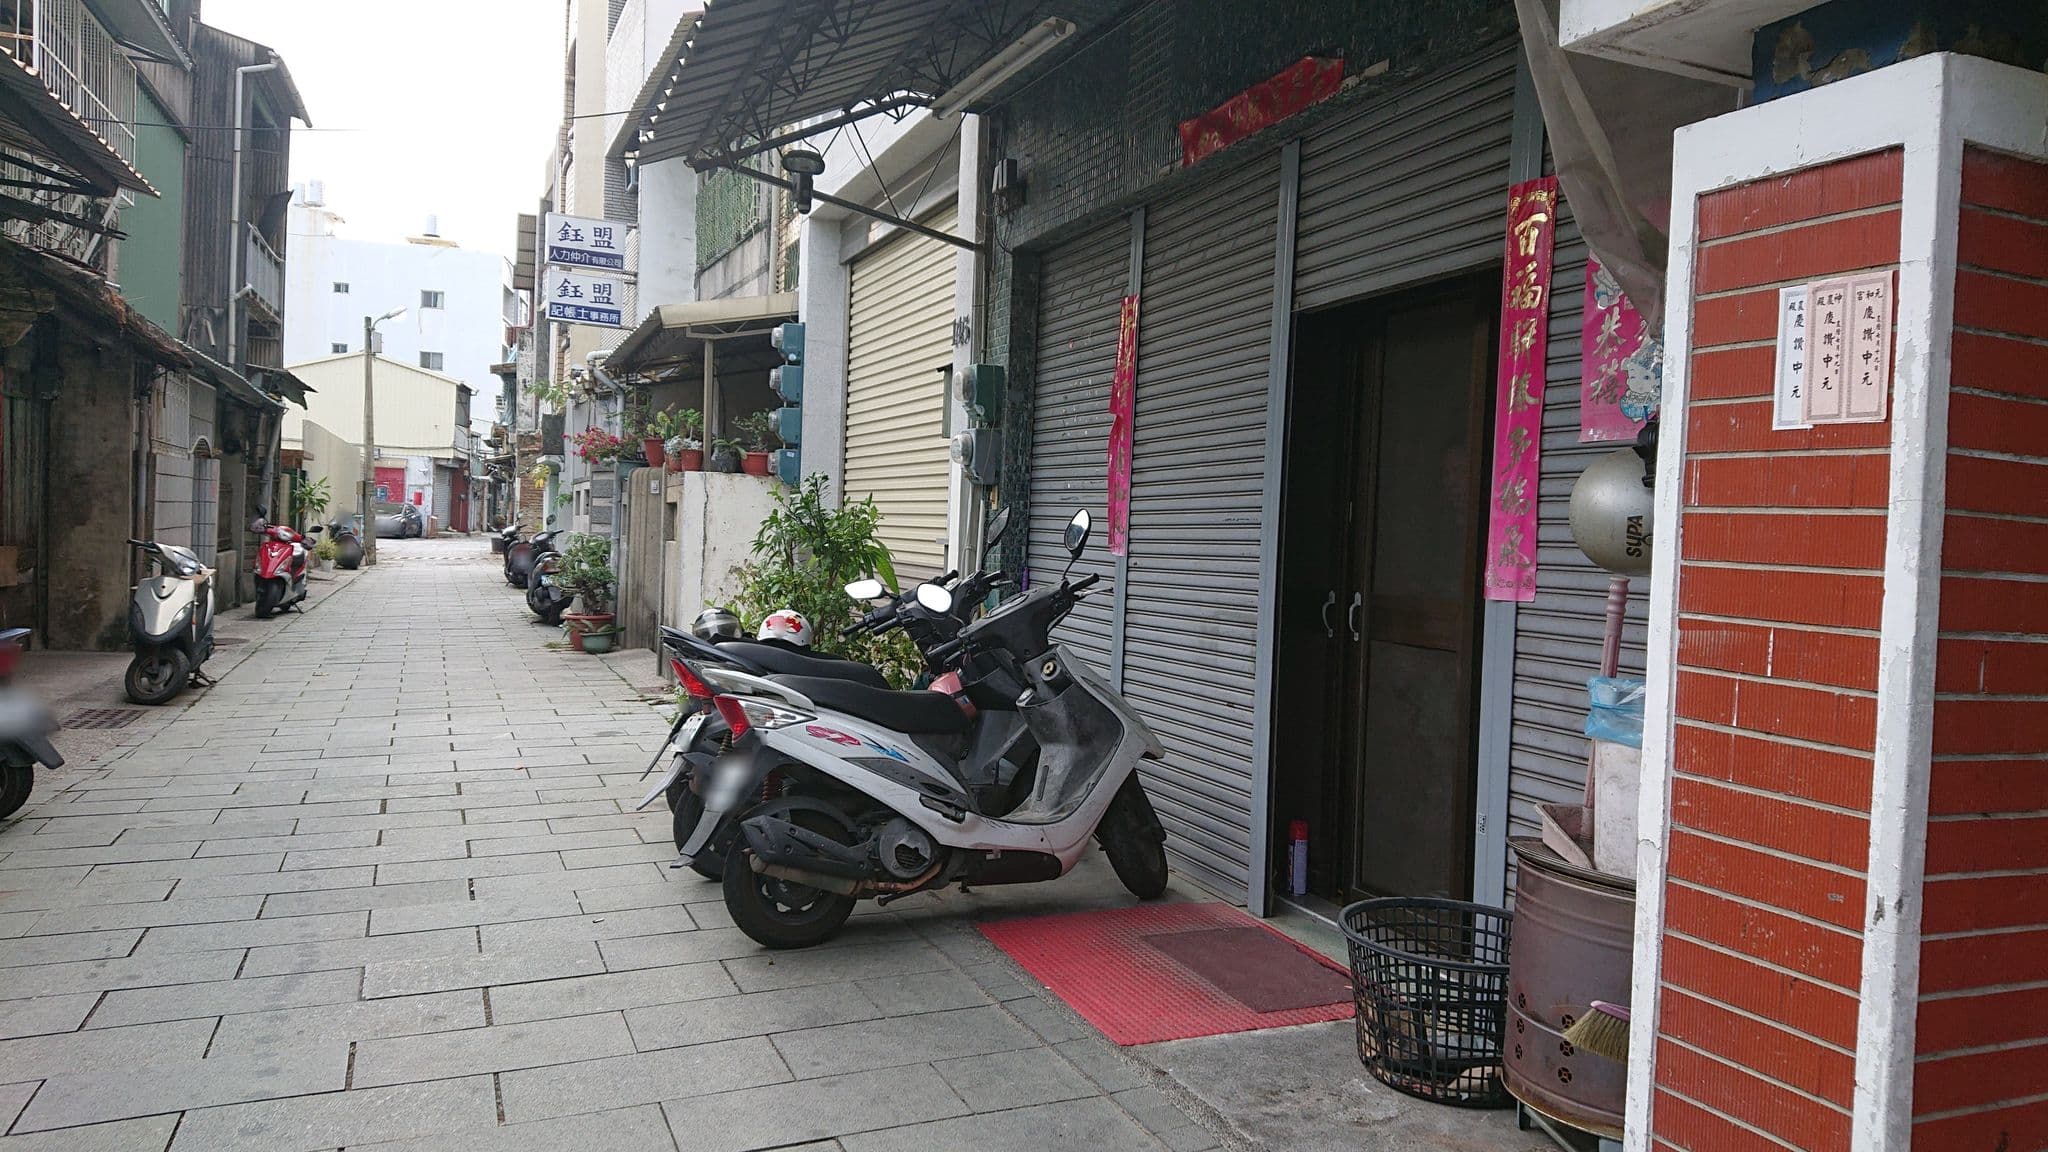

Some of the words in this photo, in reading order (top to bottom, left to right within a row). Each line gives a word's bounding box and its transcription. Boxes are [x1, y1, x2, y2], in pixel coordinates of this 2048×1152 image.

[557, 221, 616, 250] 鈺盟
[550, 247, 623, 267] 人力仲介有限公司
[556, 278, 615, 305] 鈺盟
[551, 304, 620, 323] 記帳士事務所
[1626, 515, 1644, 558] SUPA
